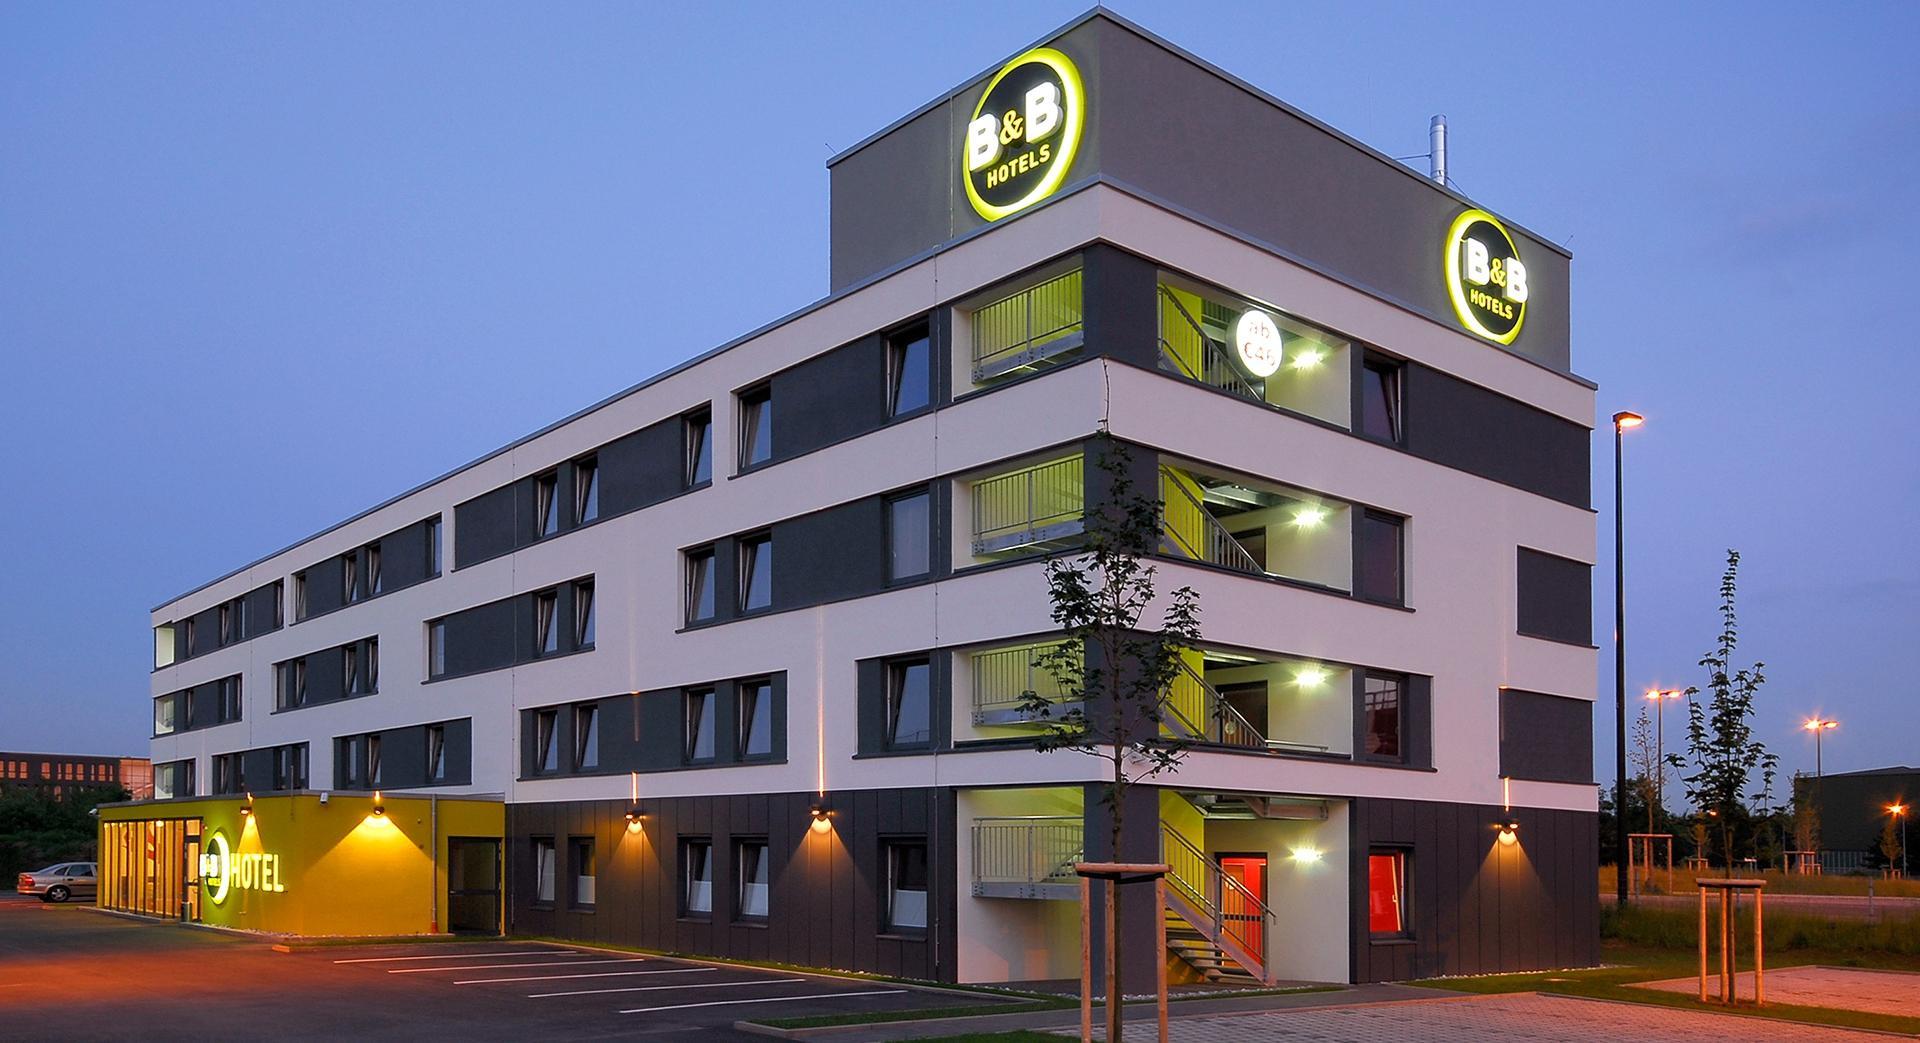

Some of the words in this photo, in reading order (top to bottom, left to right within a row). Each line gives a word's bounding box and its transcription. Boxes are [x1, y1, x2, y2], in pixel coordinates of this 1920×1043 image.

[968, 82, 1063, 172] B&B
[986, 144, 1051, 189] HOTELS
[1463, 237, 1529, 303] B&B
[1470, 288, 1513, 320] HOTELS
[230, 853, 285, 893] HOTEL
